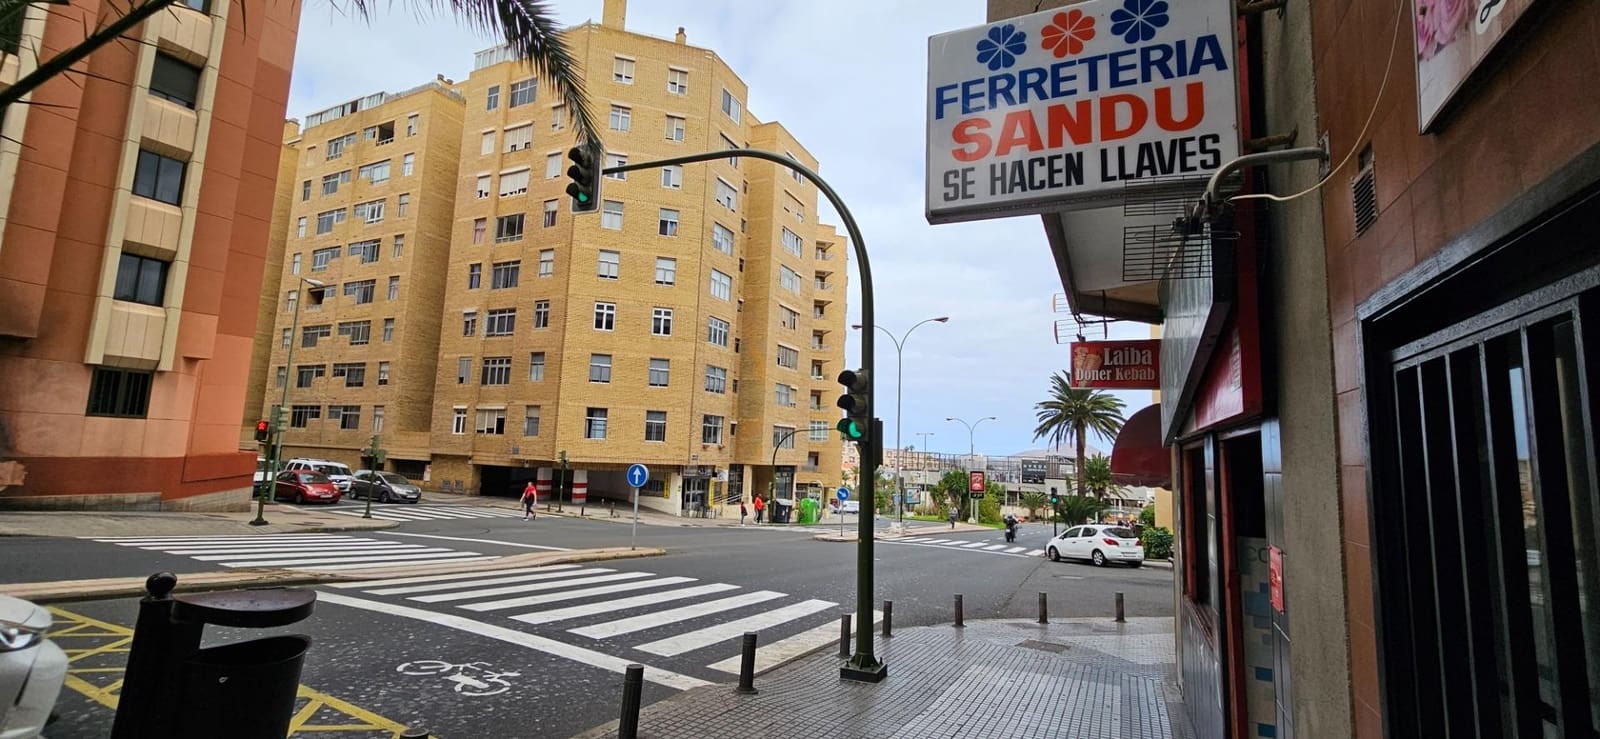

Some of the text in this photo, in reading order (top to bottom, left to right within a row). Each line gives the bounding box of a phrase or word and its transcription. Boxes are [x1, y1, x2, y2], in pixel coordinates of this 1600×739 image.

[935, 34, 1228, 120] FERRETERIA
[951, 82, 1205, 162] SANDU
[943, 133, 1222, 202] SE HACEN LLAVES
[1075, 368, 1156, 381] Doner Kebab
[1103, 347, 1153, 366] Laiba
